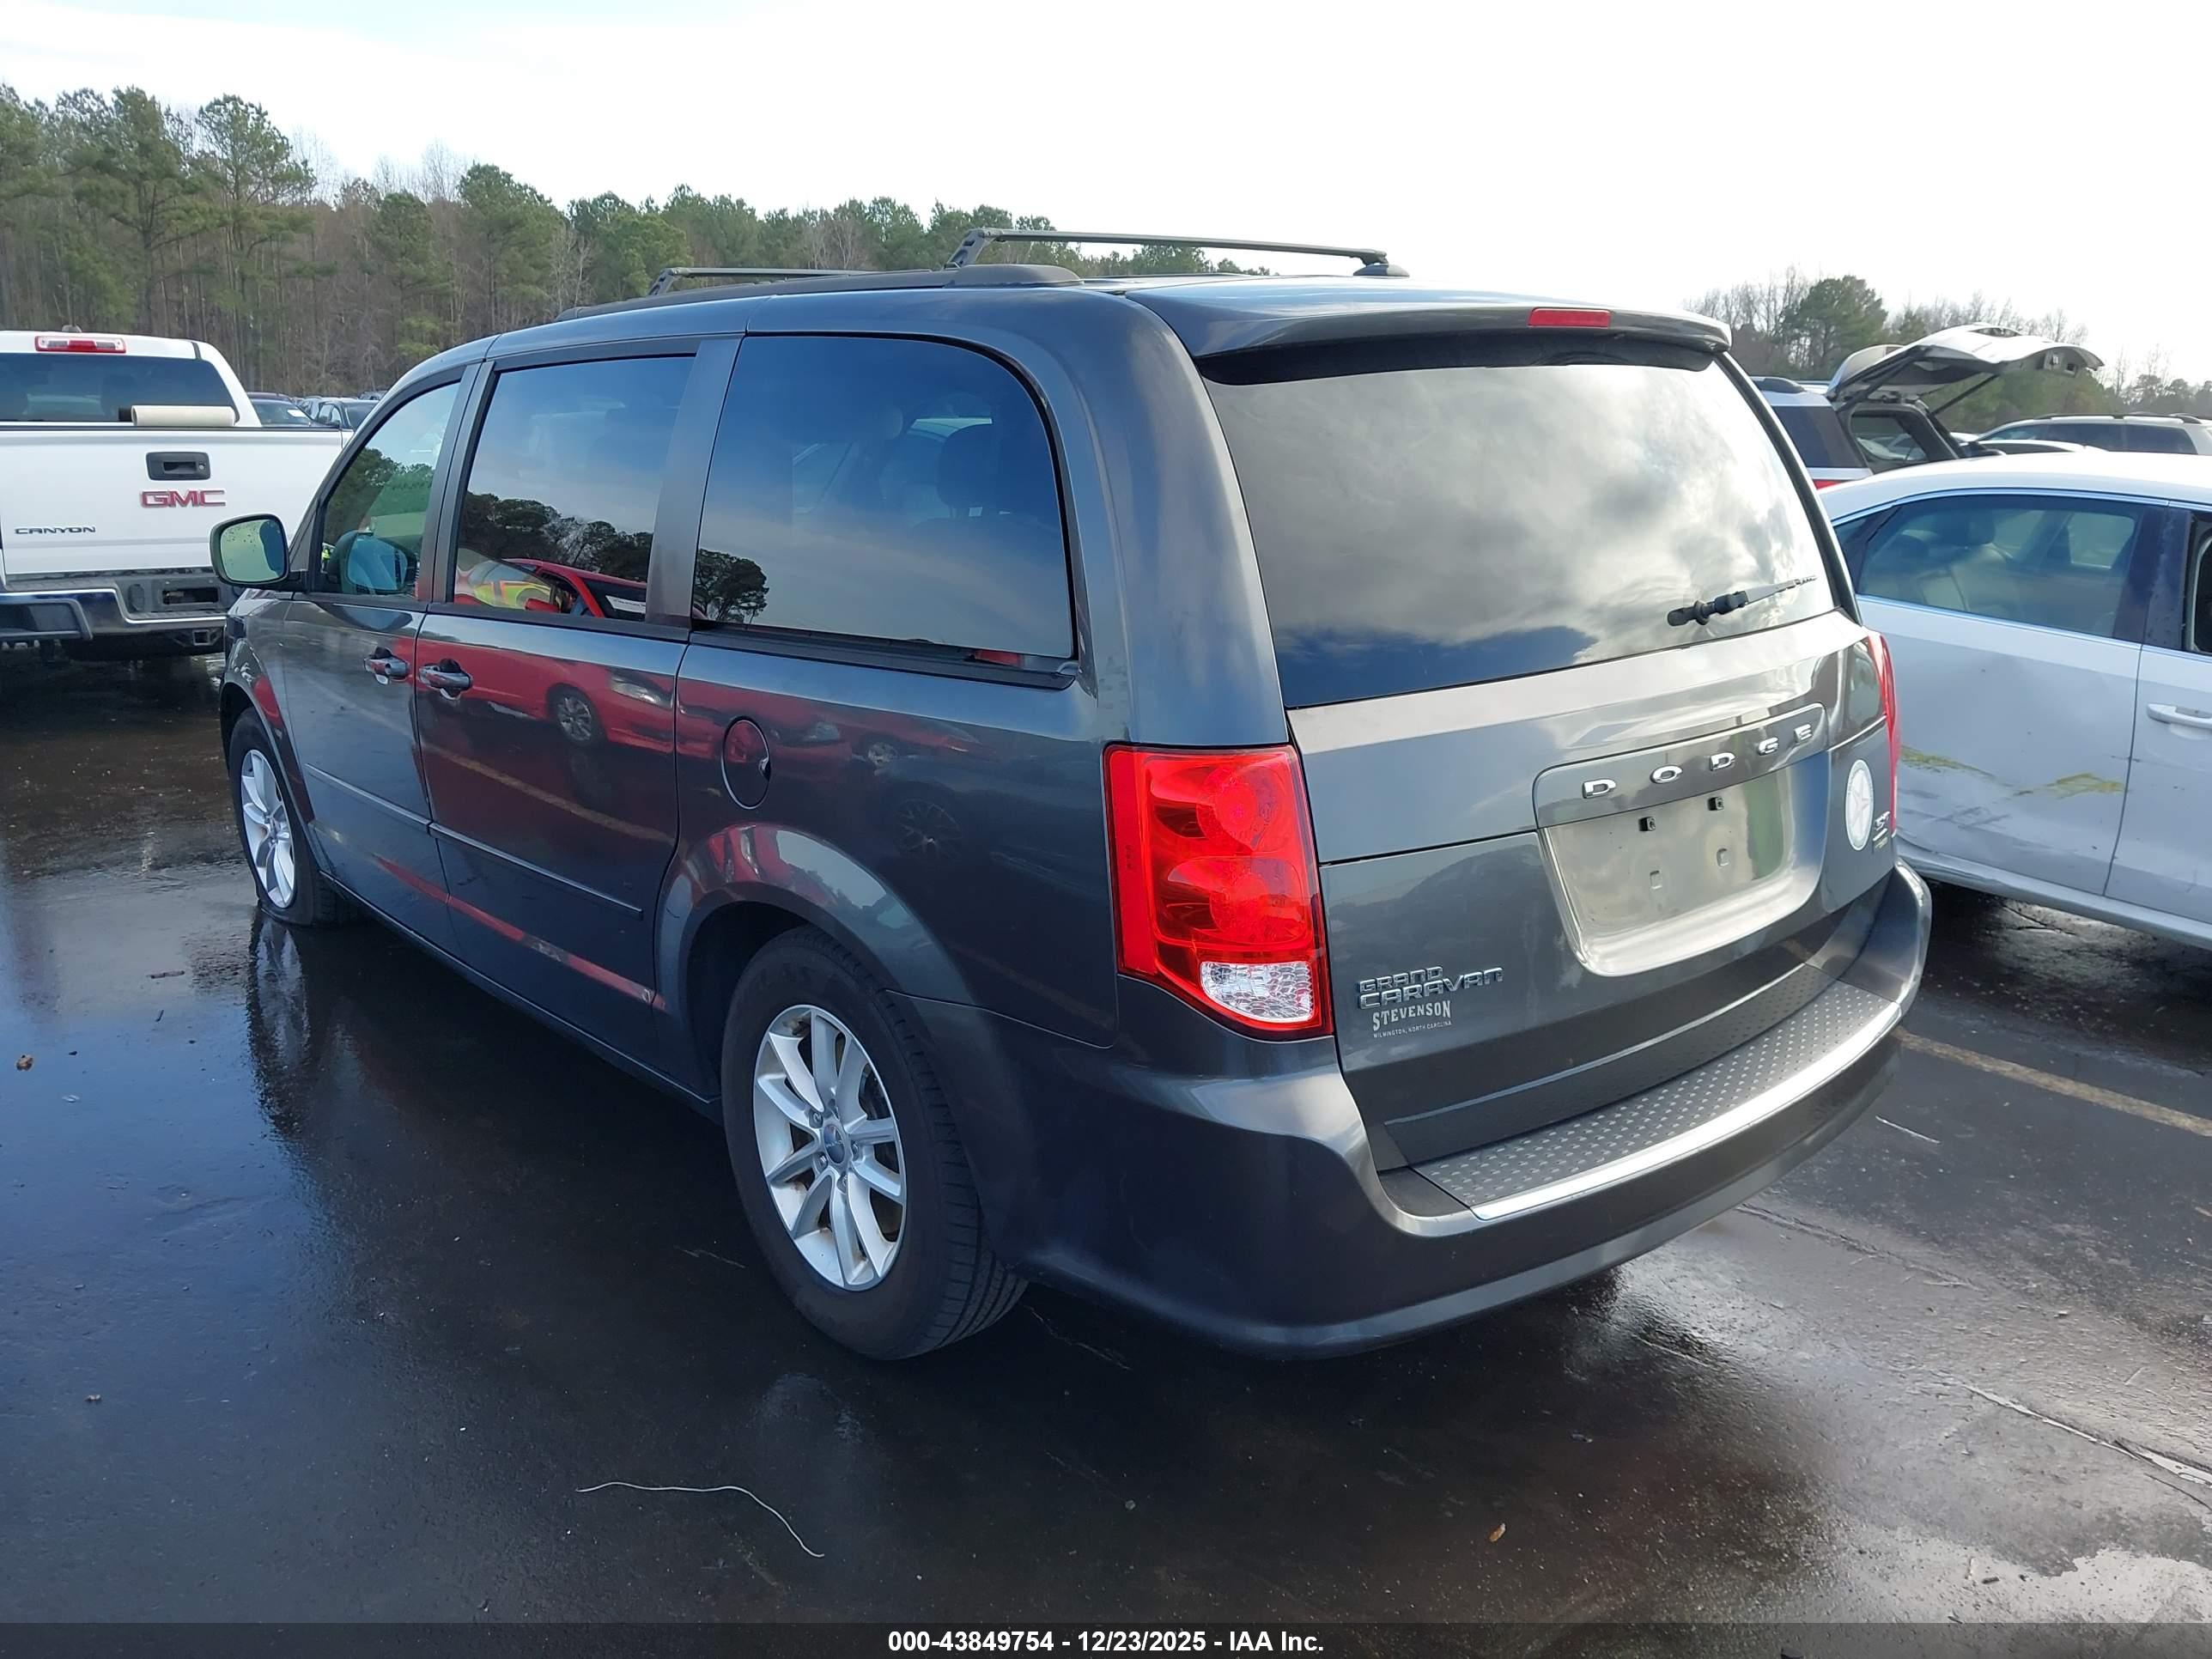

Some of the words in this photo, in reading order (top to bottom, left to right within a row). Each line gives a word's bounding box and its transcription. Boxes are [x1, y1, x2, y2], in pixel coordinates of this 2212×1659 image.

[140, 489, 227, 508] GMC
[15, 526, 96, 535] CANYON
[1582, 724, 1813, 799] DODGE
[1358, 966, 1443, 994] GRAND
[1358, 968, 1504, 1010] CARAVAN
[1372, 1000, 1451, 1031] STEVENSON
[1408, 1024, 1426, 1032] NORTH
[1426, 1020, 1452, 1030] CAROLINA
